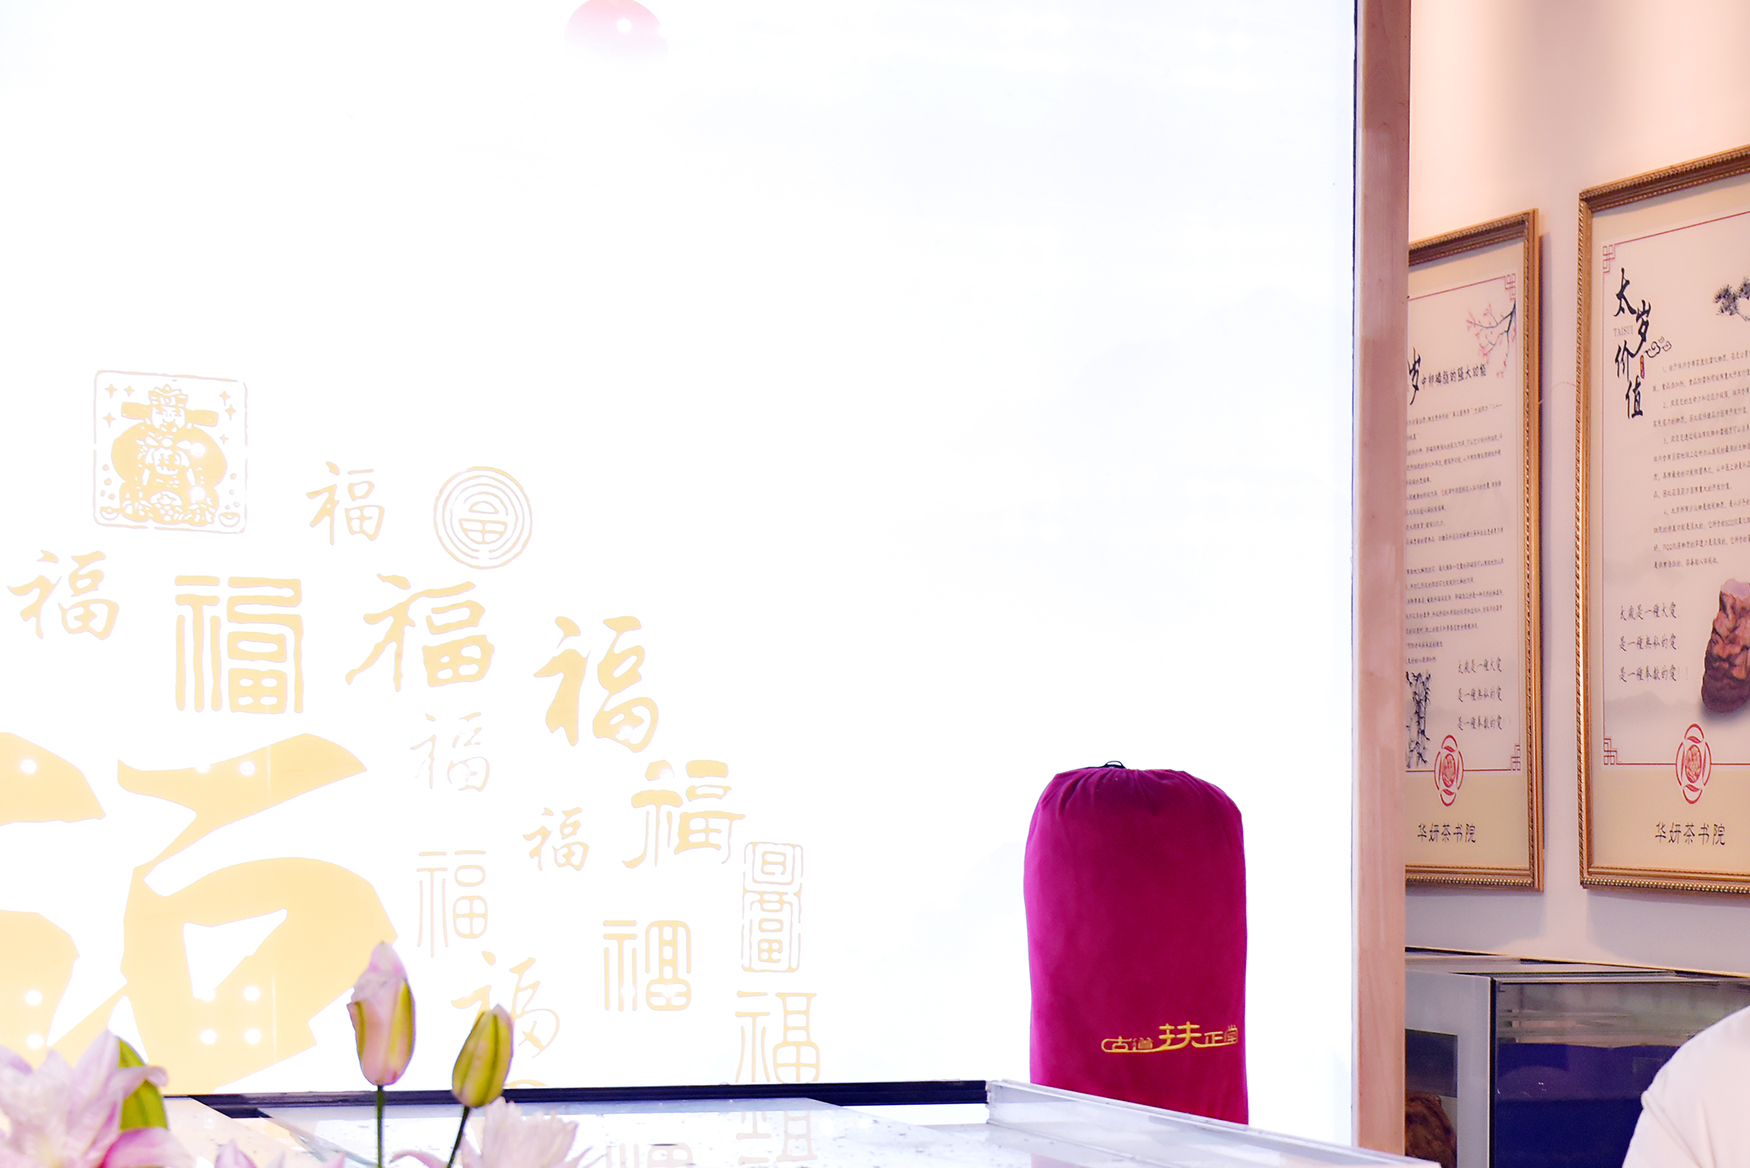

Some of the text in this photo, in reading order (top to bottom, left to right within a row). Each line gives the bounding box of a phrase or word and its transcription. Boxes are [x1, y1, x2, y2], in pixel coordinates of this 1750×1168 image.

[1613, 267, 1652, 419] 太岁价值
[9, 550, 119, 639] 福
[346, 574, 494, 691] 福
[535, 616, 658, 752] 福
[1654, 822, 1726, 846] 华妍茶书院
